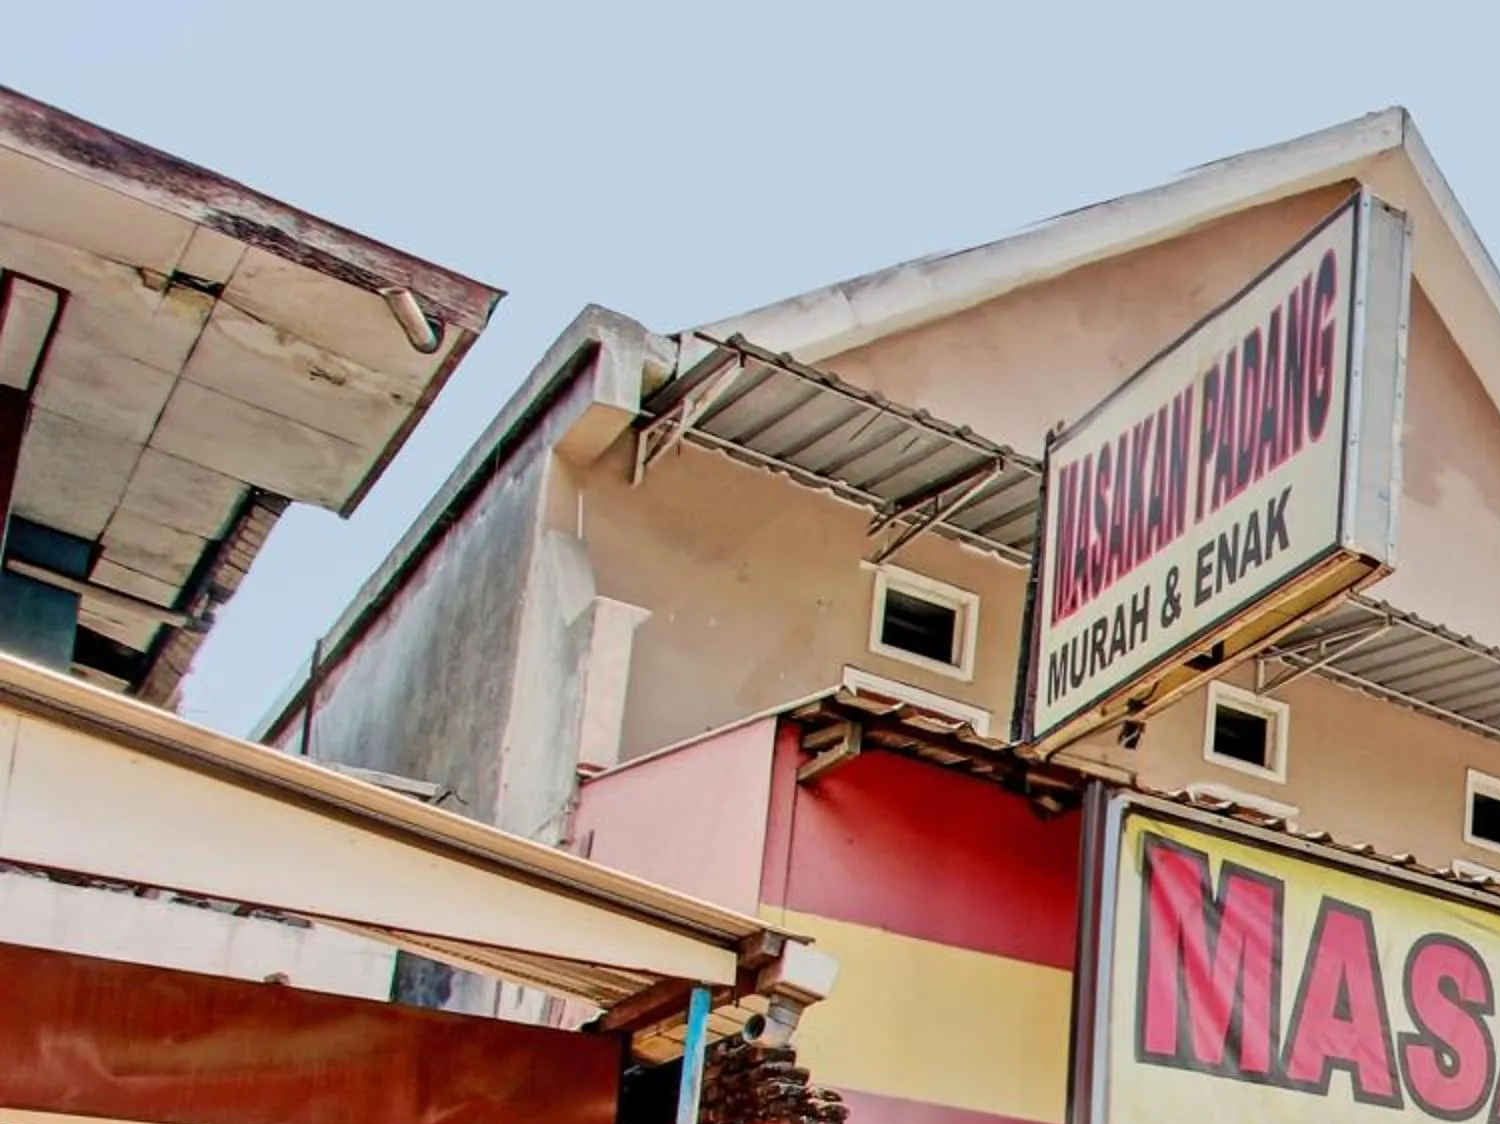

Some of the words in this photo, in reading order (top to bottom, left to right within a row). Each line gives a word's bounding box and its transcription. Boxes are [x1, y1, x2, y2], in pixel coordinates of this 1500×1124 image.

[1051, 383, 1195, 629] MASAKAN
[1194, 248, 1337, 524] PADANG
[1047, 586, 1150, 707] MURAH
[1161, 566, 1183, 629] &
[1194, 486, 1292, 608] ENAK
